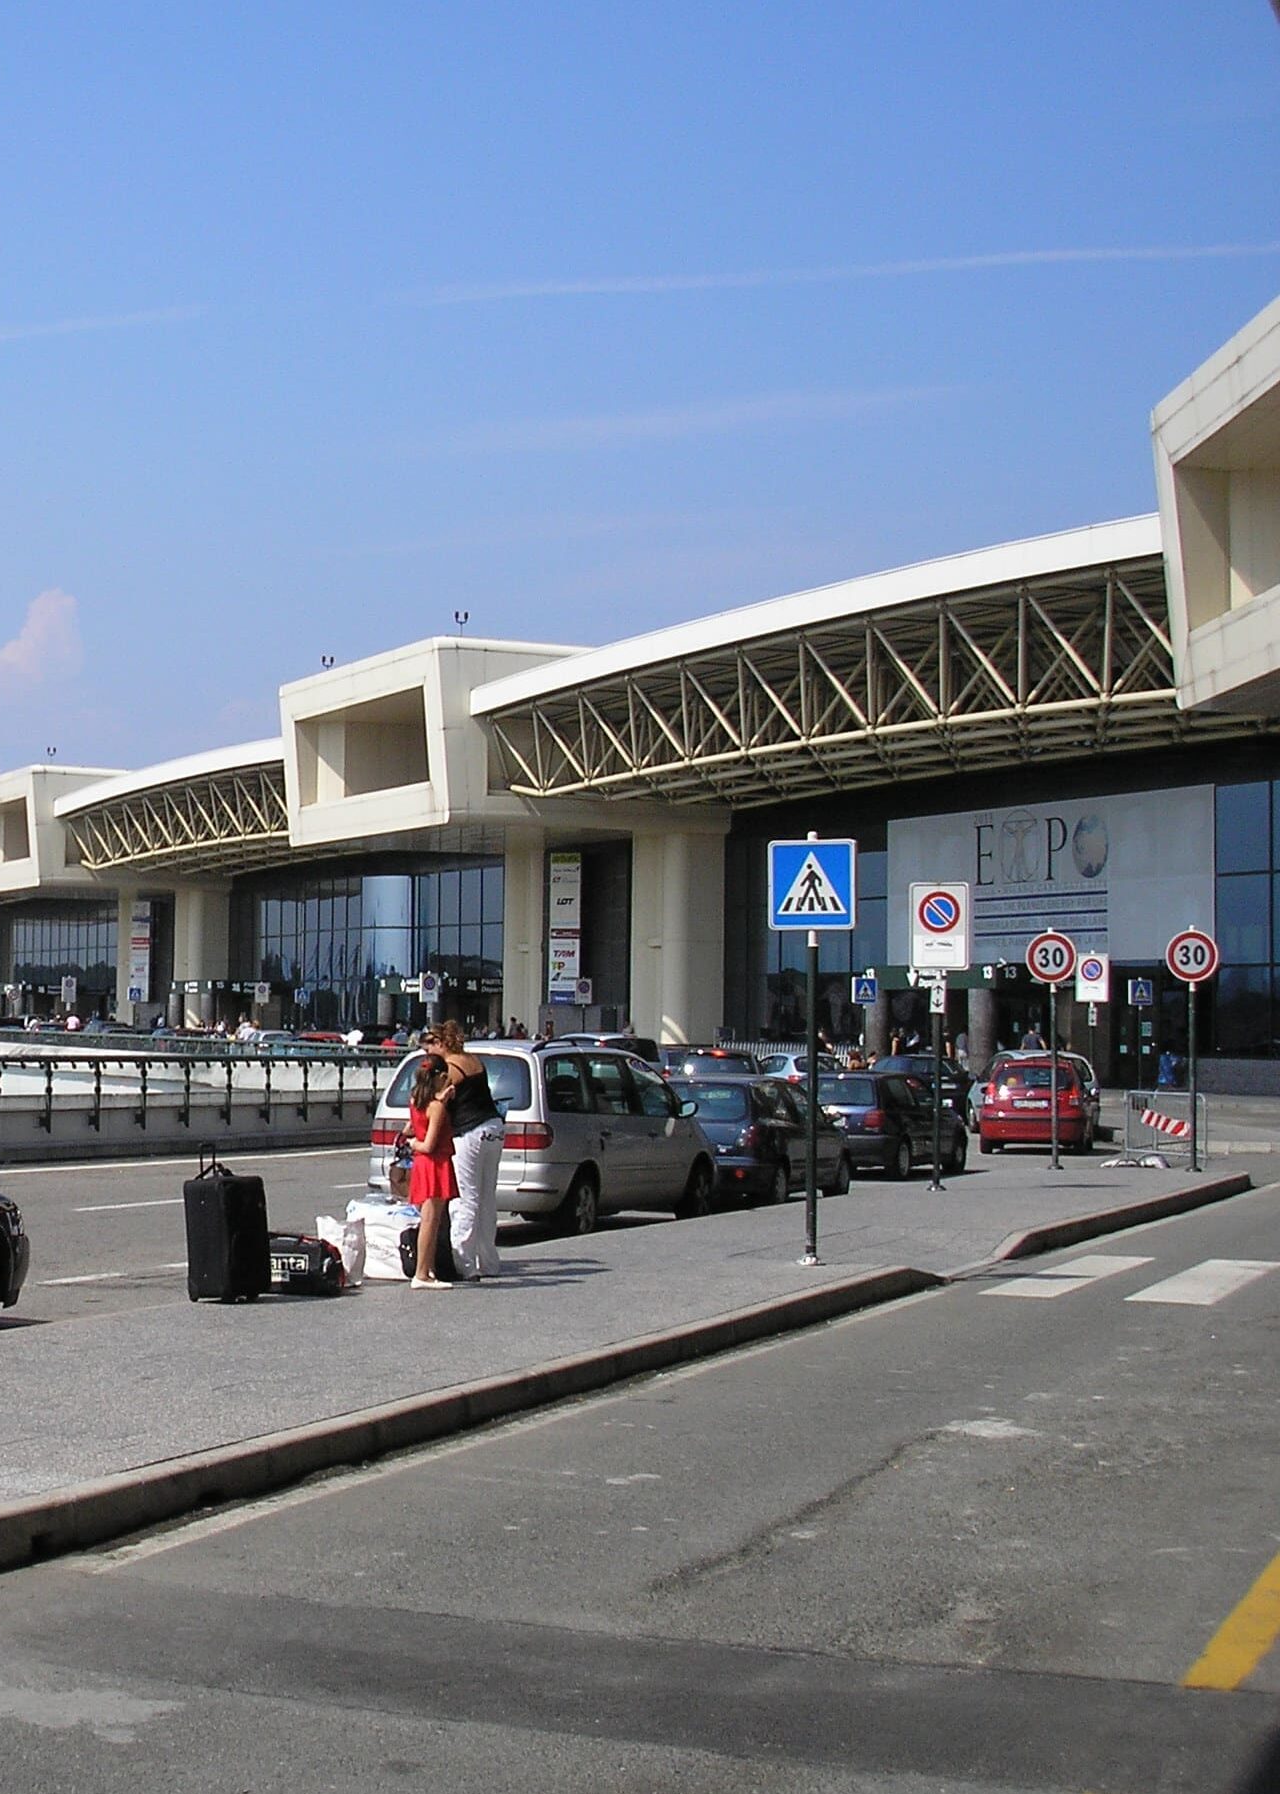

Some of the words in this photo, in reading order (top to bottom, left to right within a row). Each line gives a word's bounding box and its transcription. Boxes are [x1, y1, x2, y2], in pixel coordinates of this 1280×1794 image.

[556, 897, 575, 906] LOT
[1038, 947, 1065, 968] 30
[1179, 944, 1206, 966] 30
[1003, 966, 1017, 979] 13
